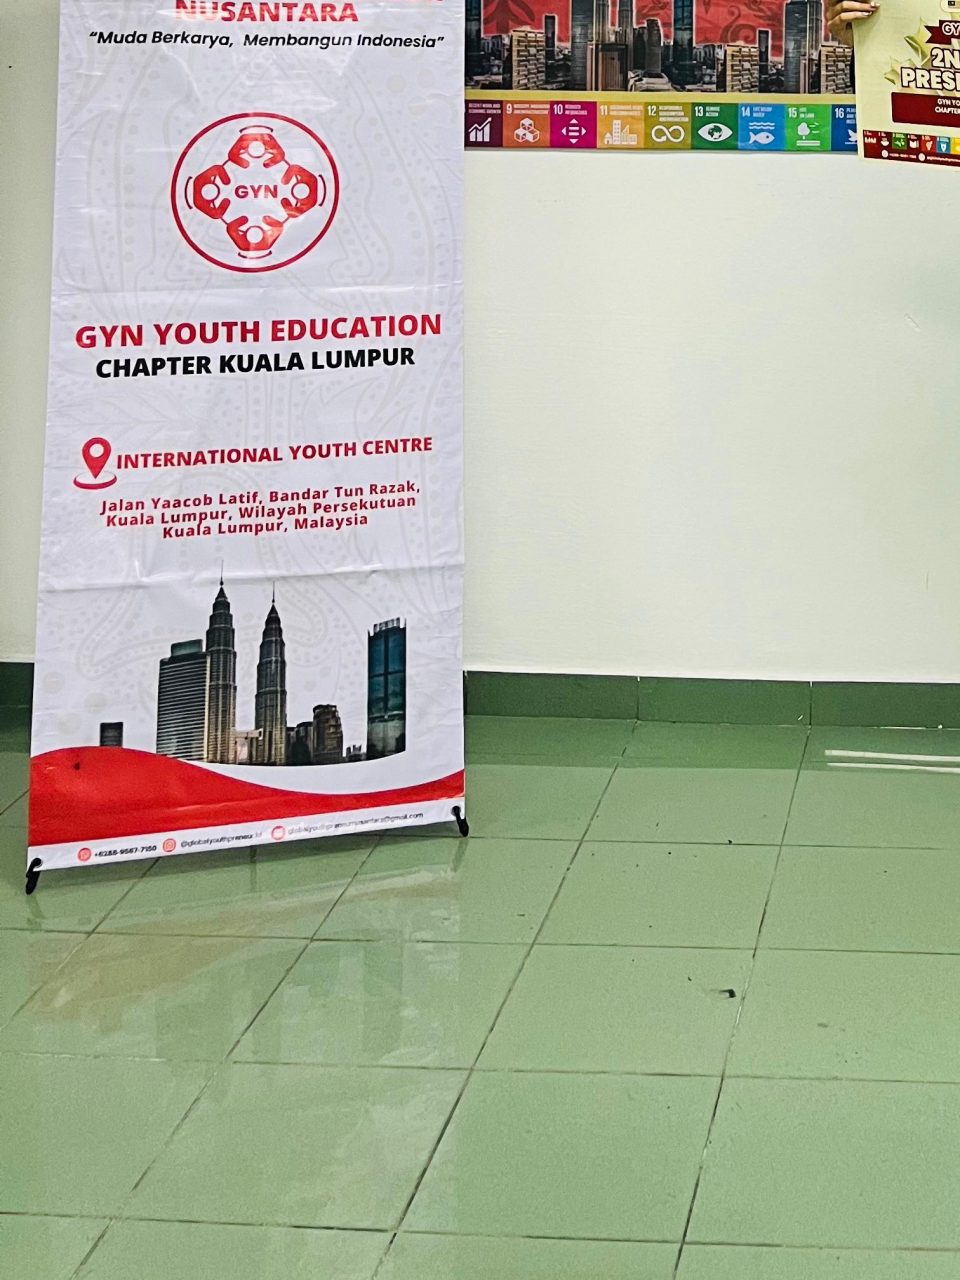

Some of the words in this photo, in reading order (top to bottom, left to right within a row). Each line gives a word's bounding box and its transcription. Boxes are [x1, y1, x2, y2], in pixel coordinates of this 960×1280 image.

[175, 0, 359, 22] NUSANTARA
[89, 31, 147, 45] “Muda
[151, 31, 234, 49] Berkarya,
[243, 34, 351, 50] Membangun
[357, 34, 445, 48] Indonesia”
[506, 103, 512, 114] 9
[553, 104, 563, 115] 10
[600, 105, 608, 115] 11
[648, 106, 657, 116] 12
[695, 106, 704, 117] 13
[741, 107, 750, 117] 14
[788, 107, 797, 118] 15
[835, 108, 844, 118] 16
[234, 185, 278, 199] GYN
[75, 325, 143, 349] GYN
[153, 320, 260, 346] YOUTH
[271, 313, 442, 342] EDUCATION
[95, 355, 212, 378] CHAPTER
[220, 351, 304, 373] KUALA
[311, 347, 415, 370] LUMPUR
[116, 448, 283, 469] INTERNATIONAL
[289, 442, 357, 461] YOUTH
[362, 436, 433, 455] CENTRE
[100, 498, 145, 515] Jalan
[151, 493, 213, 510] Yaacob
[219, 491, 263, 506] Latif,
[269, 487, 329, 503] Bandar
[334, 485, 364, 498] Tun
[369, 480, 421, 496] Razak,
[105, 511, 155, 527] Kuala
[161, 508, 233, 525] Lumpur,
[239, 503, 307, 521] Wilayah
[313, 495, 416, 514] Persekutuan
[162, 523, 212, 539] Kuala
[217, 520, 288, 538] Lumpur,
[294, 515, 368, 531] Malaysia
